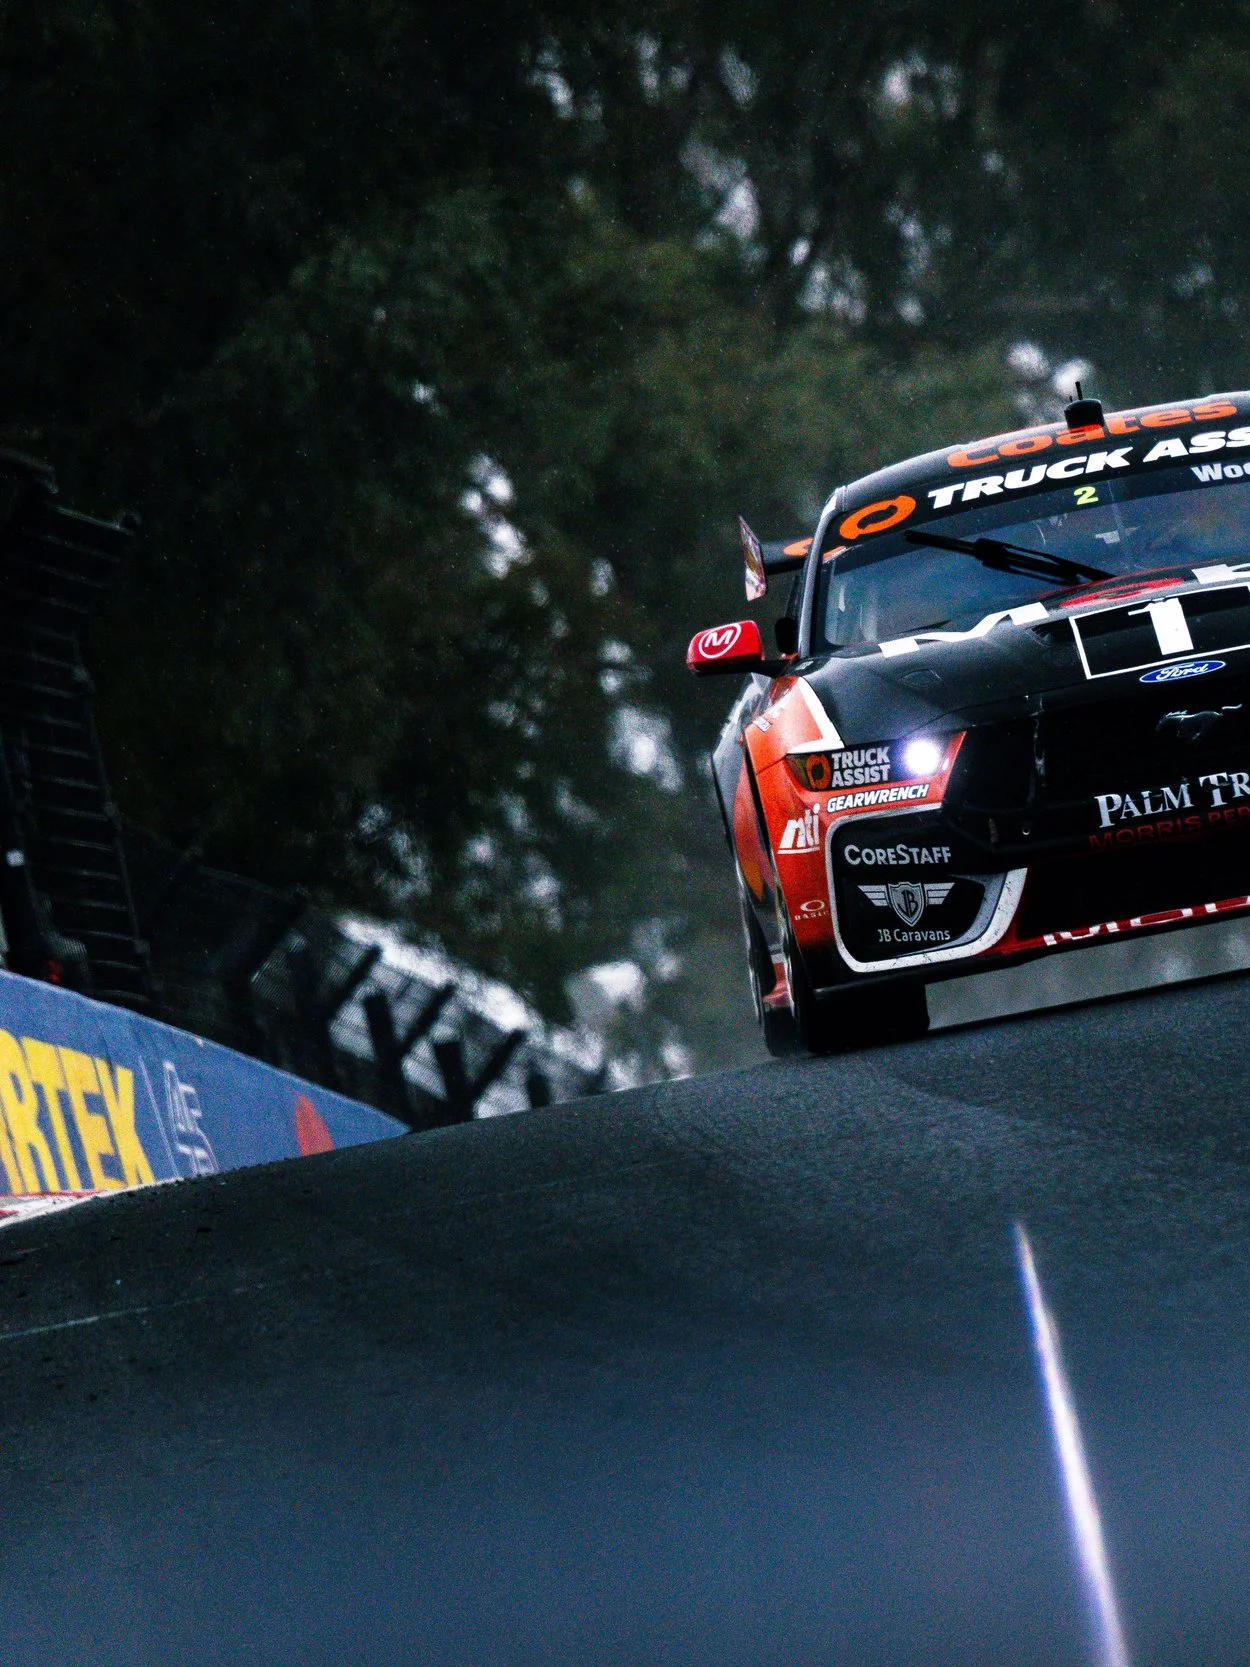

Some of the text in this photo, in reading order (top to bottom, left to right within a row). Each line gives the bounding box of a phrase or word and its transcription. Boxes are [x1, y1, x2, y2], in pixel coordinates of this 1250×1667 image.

[928, 446, 1133, 509] TRUCK
[1073, 486, 1099, 506] 2
[1128, 598, 1194, 656] 1
[1155, 662, 1209, 680] Ford
[831, 746, 890, 769] TRUCK
[831, 765, 891, 788] ASSIST
[826, 784, 930, 813] GEARWRENCH
[1088, 815, 1201, 849] MORRIS
[877, 928, 951, 942] JB Caravans
[0, 1027, 156, 1195] RTEX
